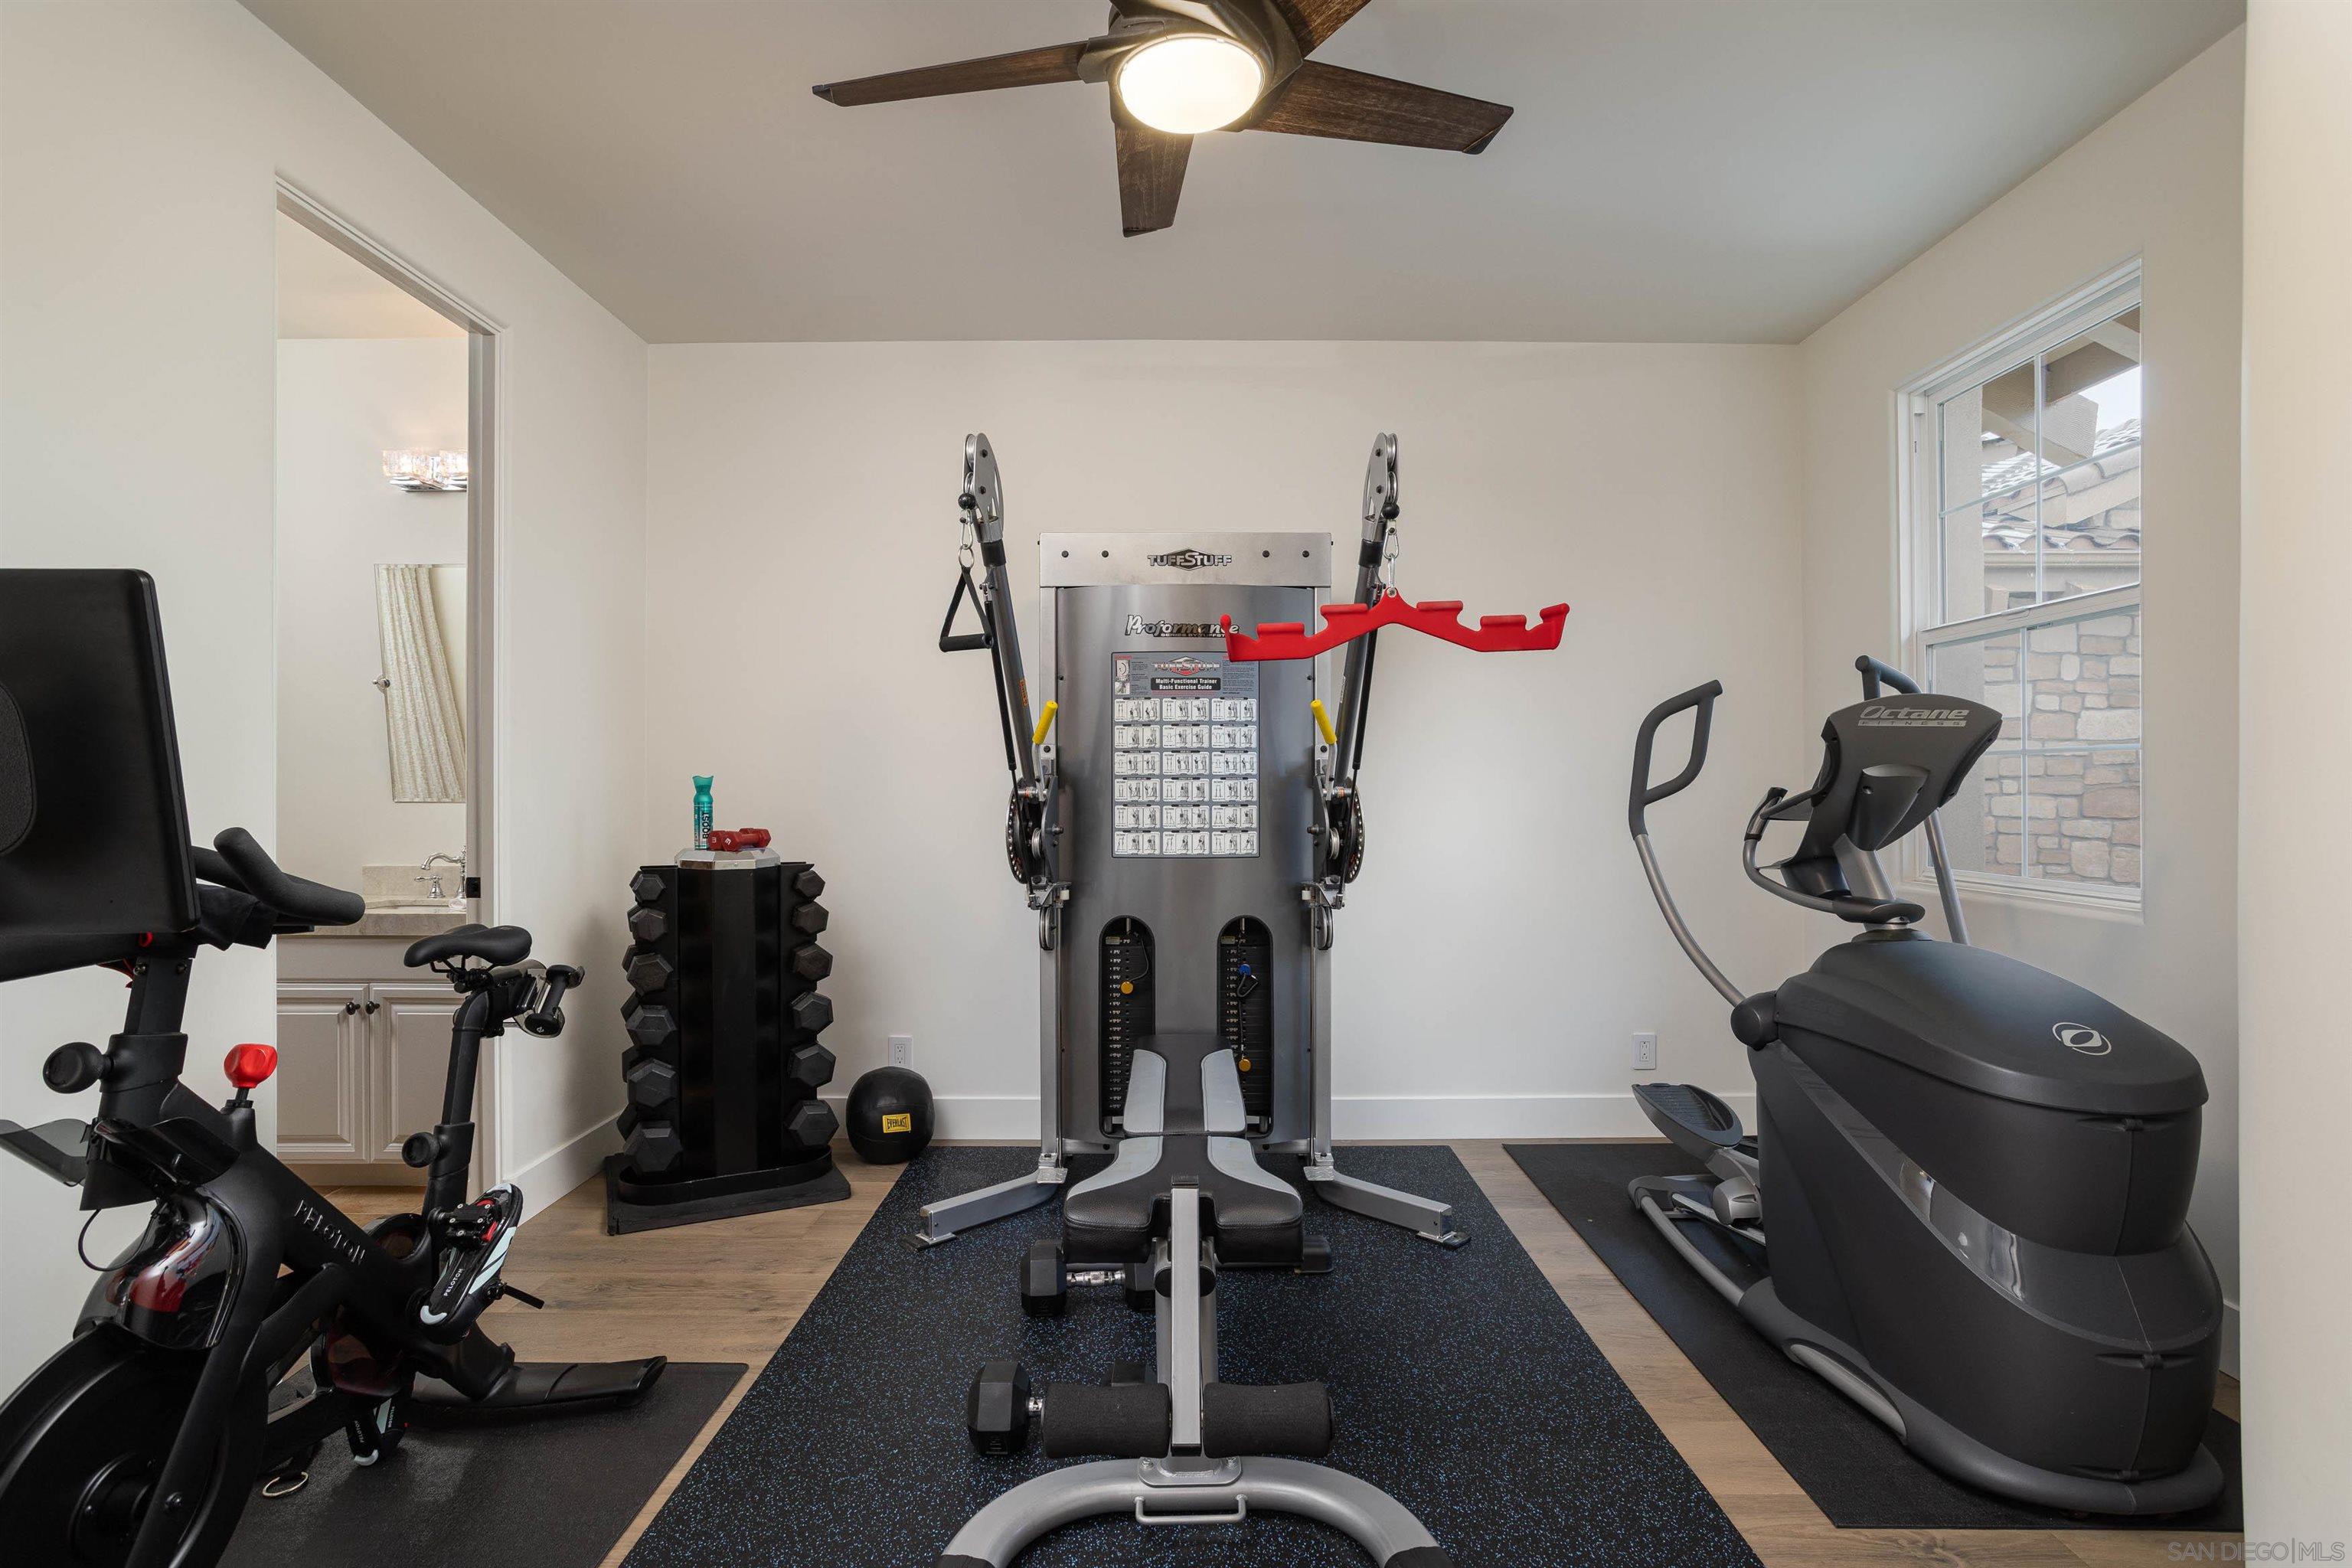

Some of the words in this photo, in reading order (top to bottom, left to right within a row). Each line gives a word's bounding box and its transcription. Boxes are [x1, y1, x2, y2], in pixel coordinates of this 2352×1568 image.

[1148, 552, 1232, 567] TUFFSTUFF
[1860, 705, 1970, 719] Octane
[887, 1117, 907, 1129] EVERLAST
[443, 1268, 463, 1296] PELOTON
